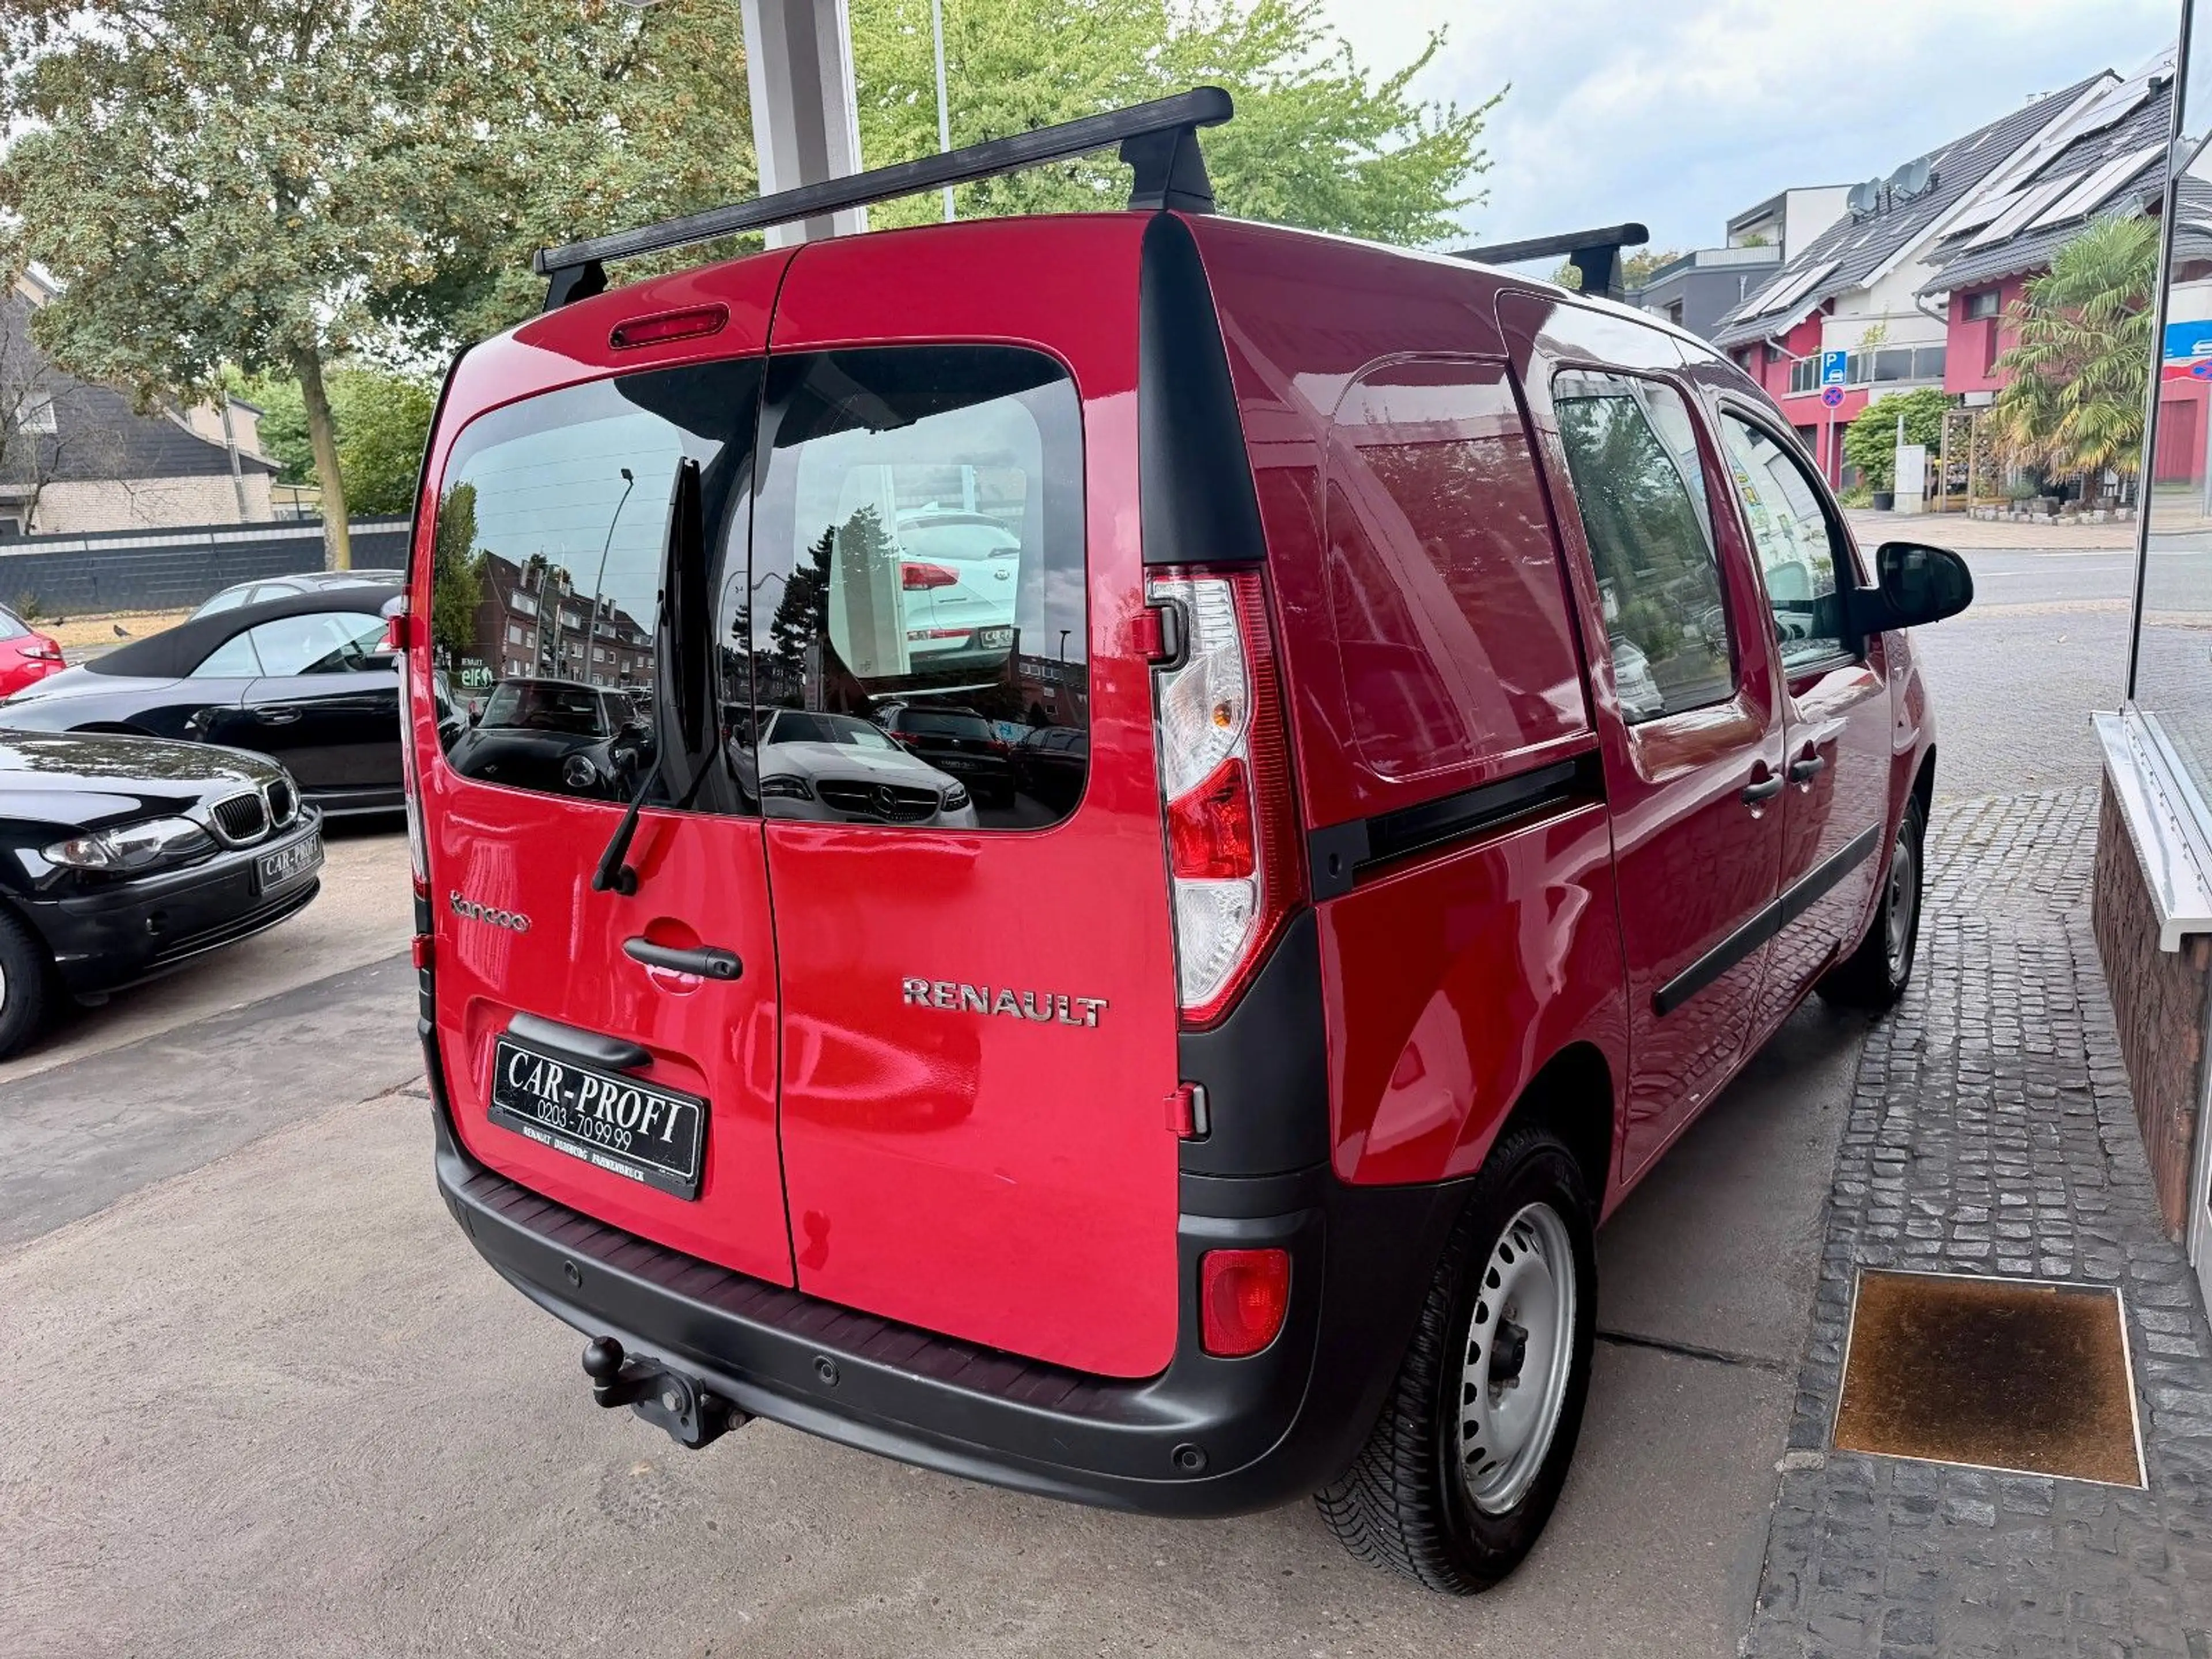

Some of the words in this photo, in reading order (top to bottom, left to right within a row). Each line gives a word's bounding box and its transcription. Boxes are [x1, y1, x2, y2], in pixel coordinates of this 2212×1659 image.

[1826, 353, 1838, 368] P
[461, 668, 481, 687] elf
[902, 977, 1109, 1028] RENAULT
[508, 1052, 683, 1143] CAR-PROFI
[537, 1099, 566, 1127] 0203
